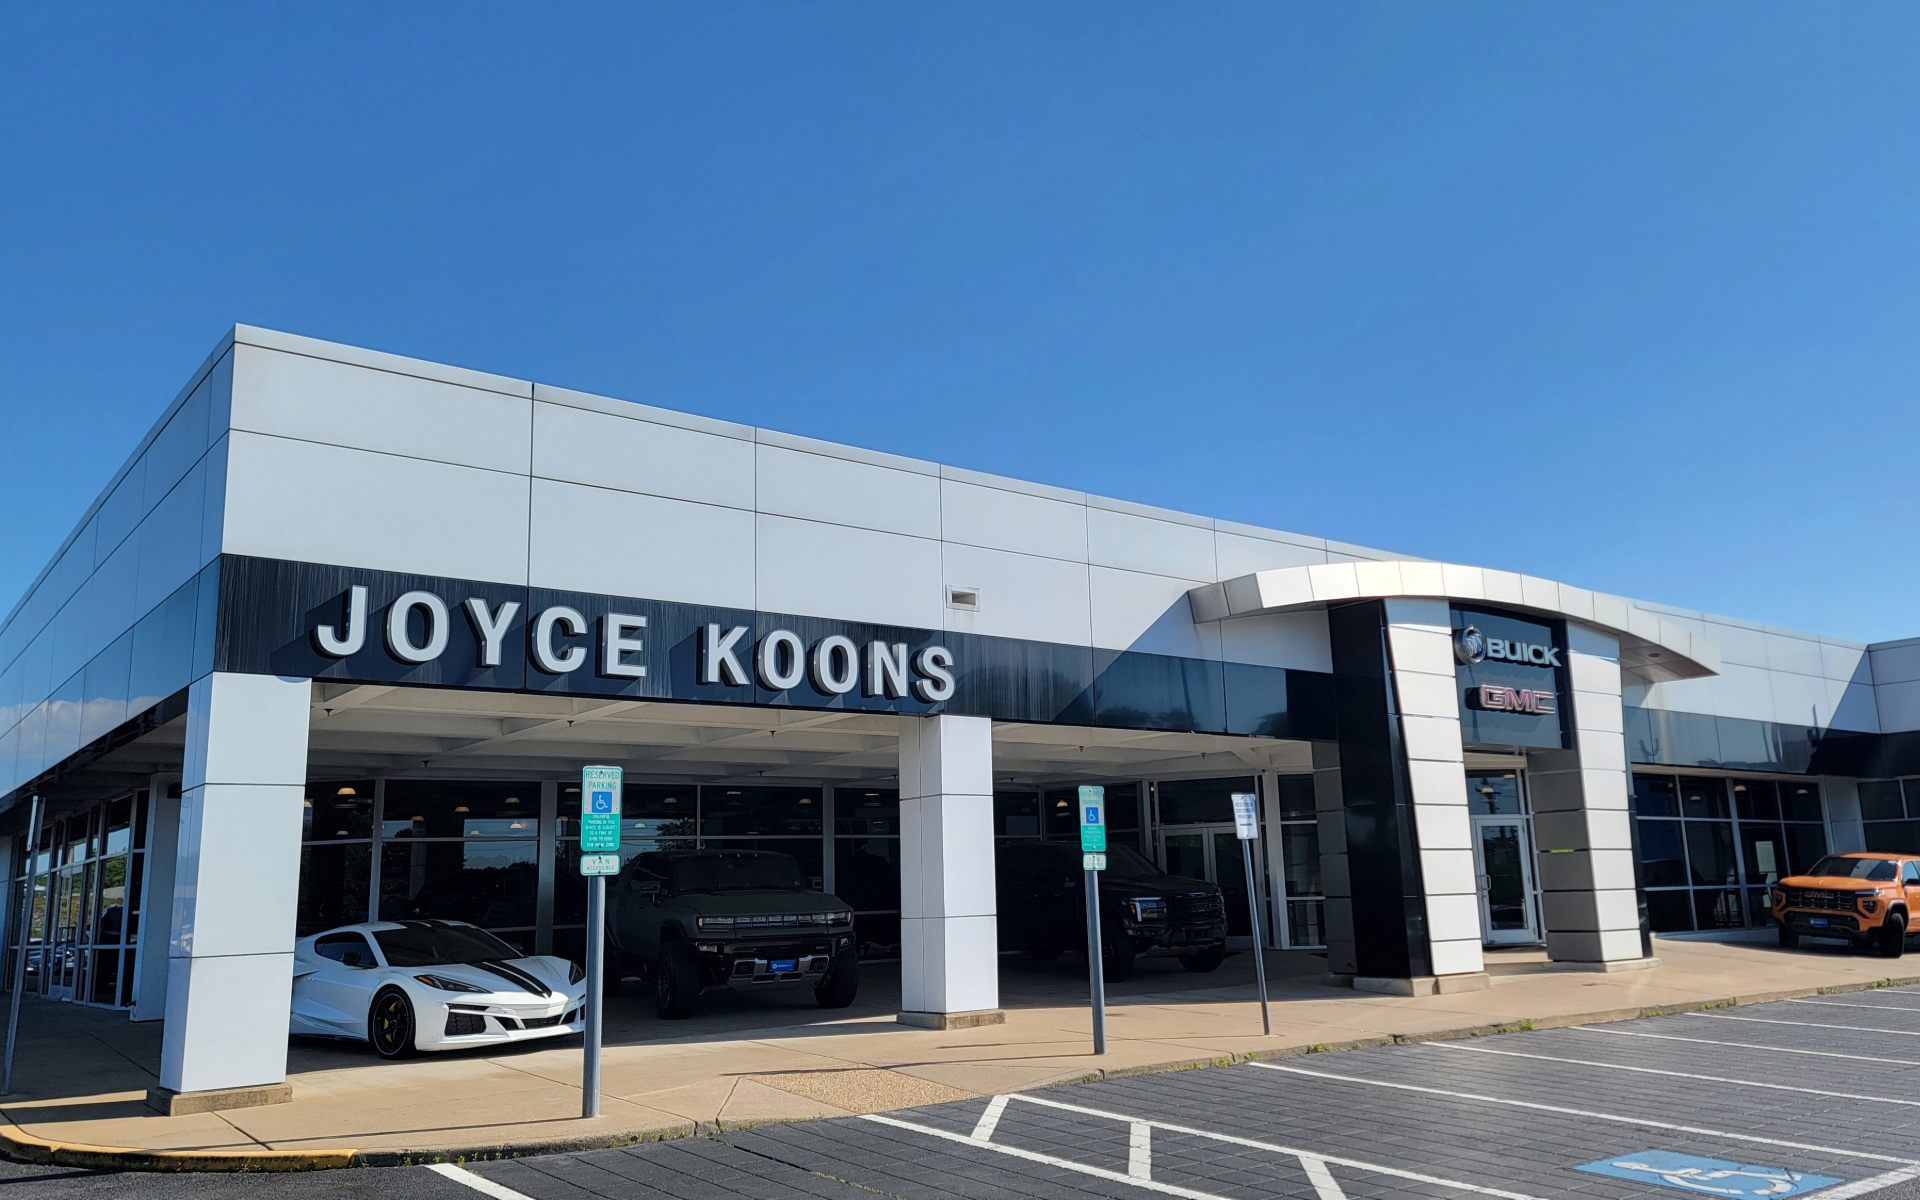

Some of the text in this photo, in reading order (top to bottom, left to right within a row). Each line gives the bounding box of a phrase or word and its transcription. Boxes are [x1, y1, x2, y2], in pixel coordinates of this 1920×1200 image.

[314, 584, 956, 702] JOYCE KOONS
[1486, 637, 1562, 667] BUICK
[1480, 684, 1556, 714] GMC
[586, 770, 620, 779] RESERVED
[588, 781, 617, 790] PARKING
